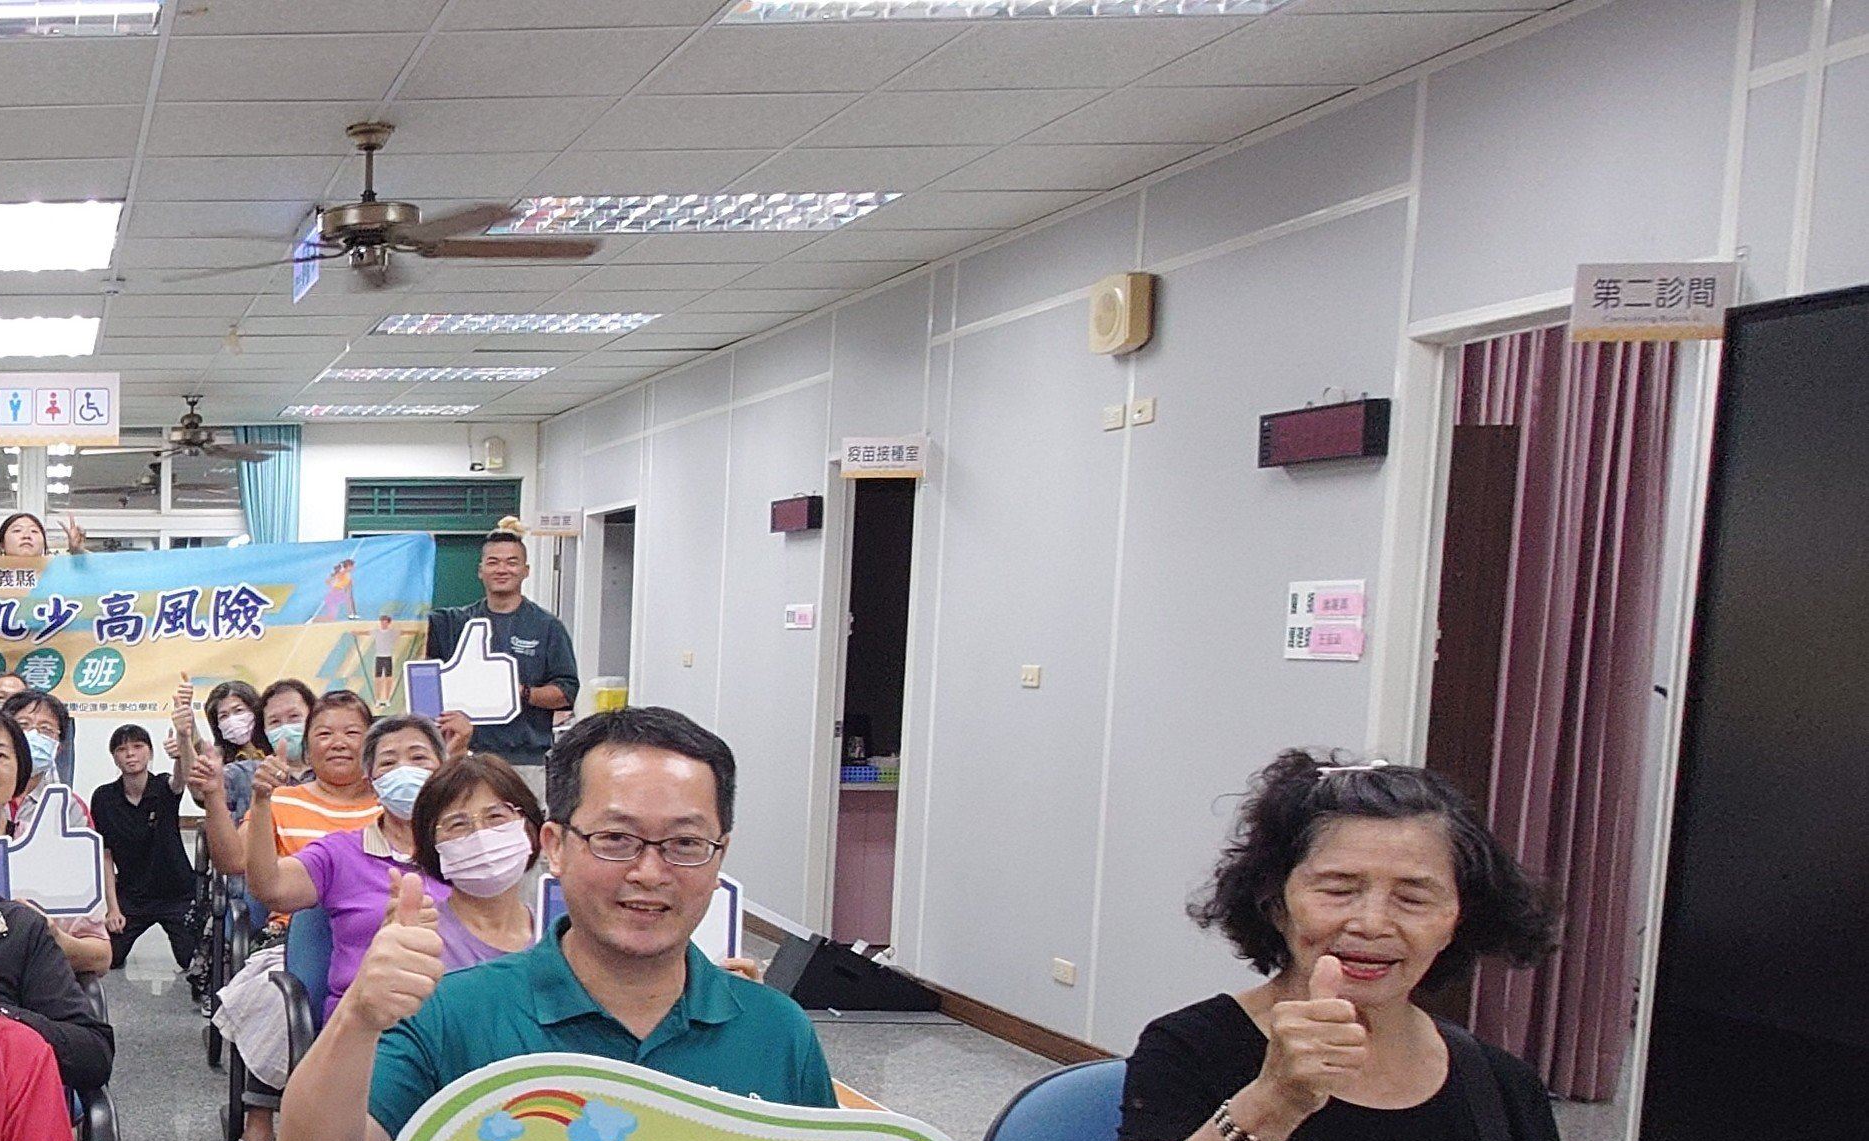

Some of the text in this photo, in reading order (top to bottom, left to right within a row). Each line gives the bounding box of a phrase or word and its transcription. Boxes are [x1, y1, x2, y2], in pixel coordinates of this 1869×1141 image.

[1593, 277, 1717, 309] 第二診間
[848, 445, 919, 462] 疫苗接種室
